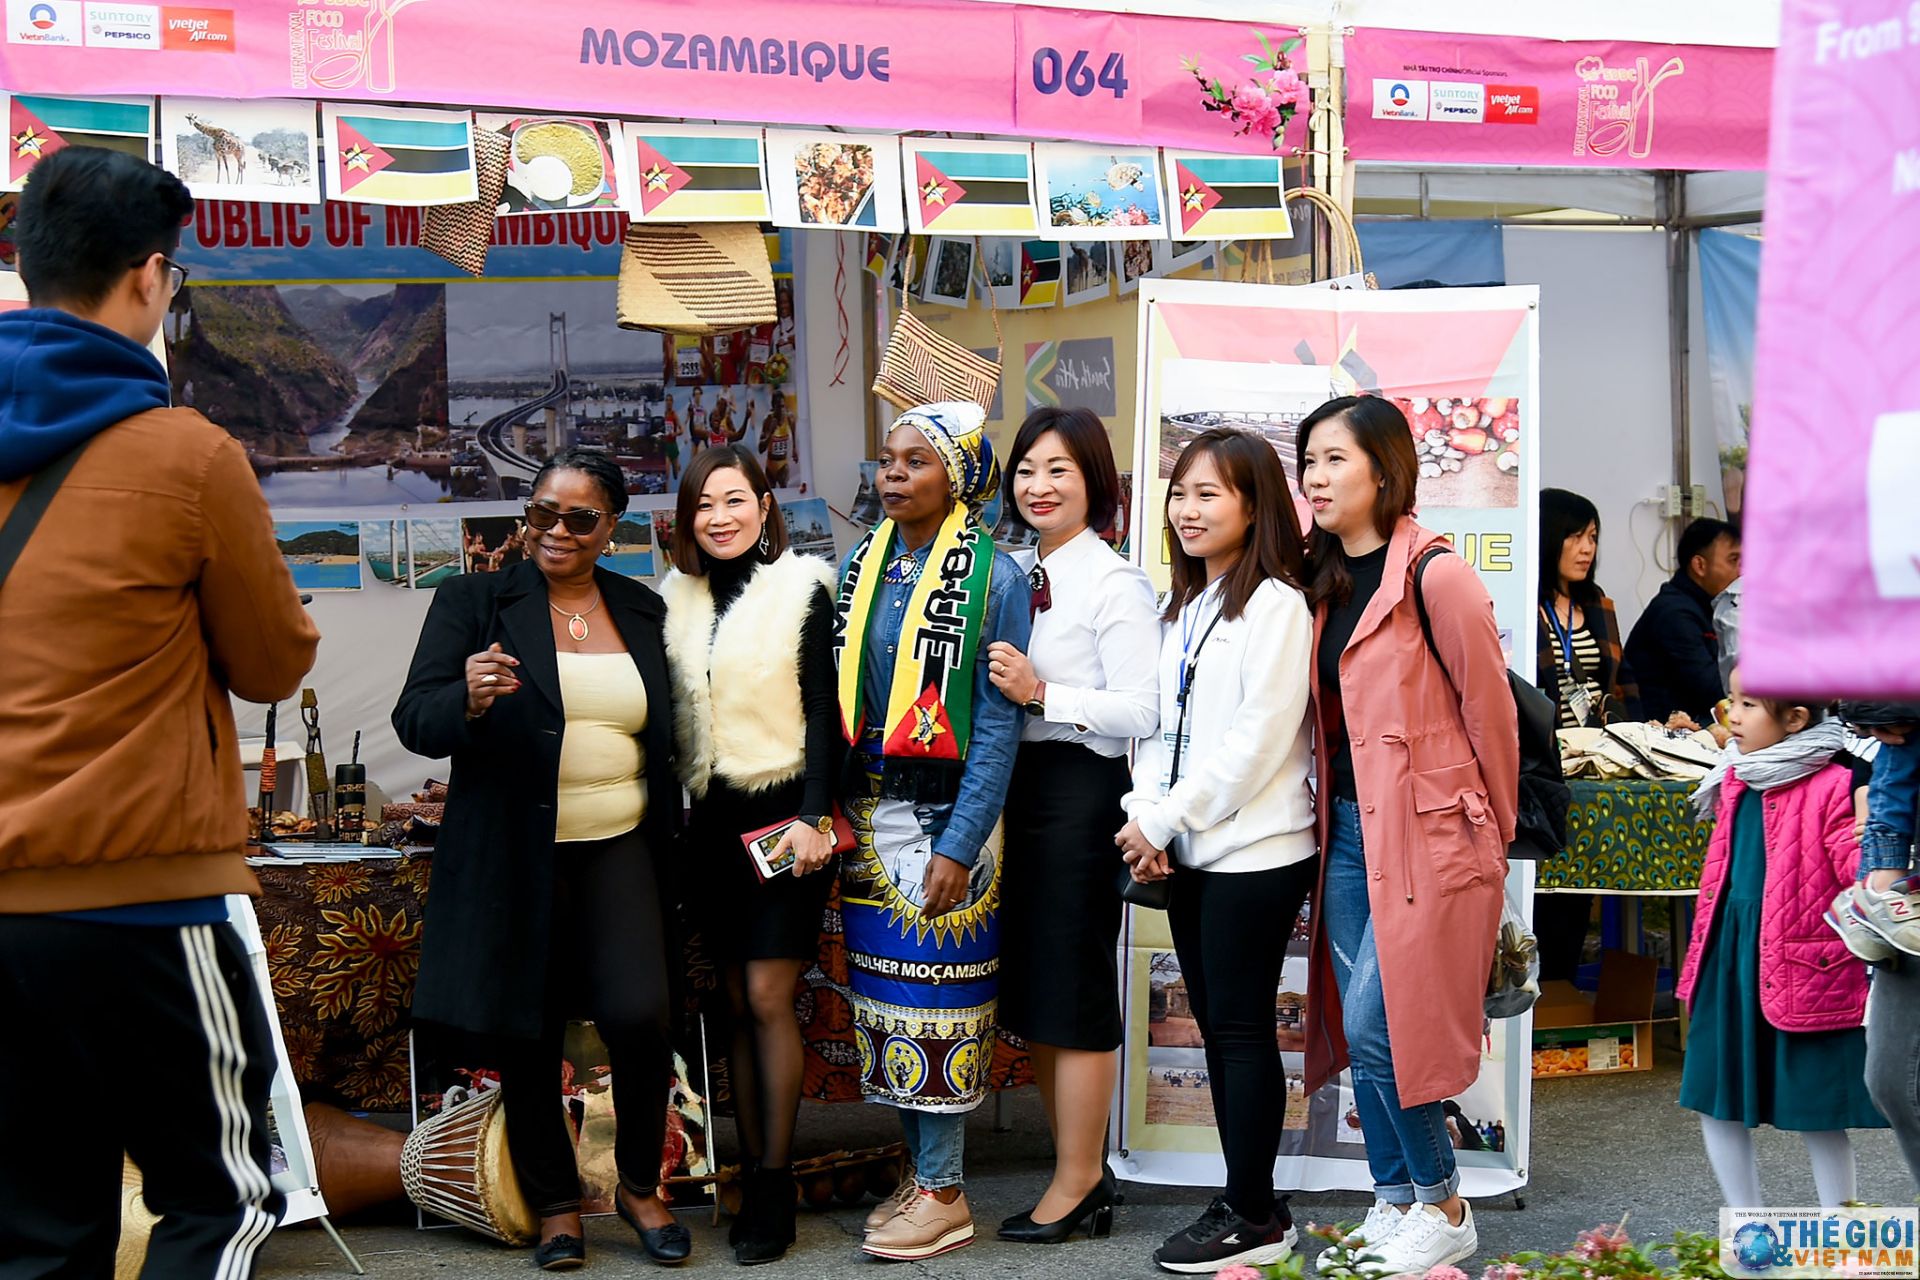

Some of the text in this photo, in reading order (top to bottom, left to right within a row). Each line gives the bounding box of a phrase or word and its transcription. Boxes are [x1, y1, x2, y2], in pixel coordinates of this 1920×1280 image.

[89, 11, 152, 23] SUNTORY
[305, 9, 344, 28] FOOD
[20, 32, 66, 42] VietinBank
[104, 31, 151, 40] PEPSICO
[1813, 17, 1903, 65] From
[289, 9, 307, 89] INTERNATIONAL
[307, 29, 363, 63] Festival
[580, 26, 889, 83] MOZAMBIQUE
[1032, 46, 1129, 99] 064
[1433, 89, 1480, 99] SUNTORY
[1591, 84, 1618, 100] FOOD
[1382, 109, 1416, 118] VietinBank
[1443, 106, 1477, 114] PEPSICO
[325, 202, 371, 249] OF
